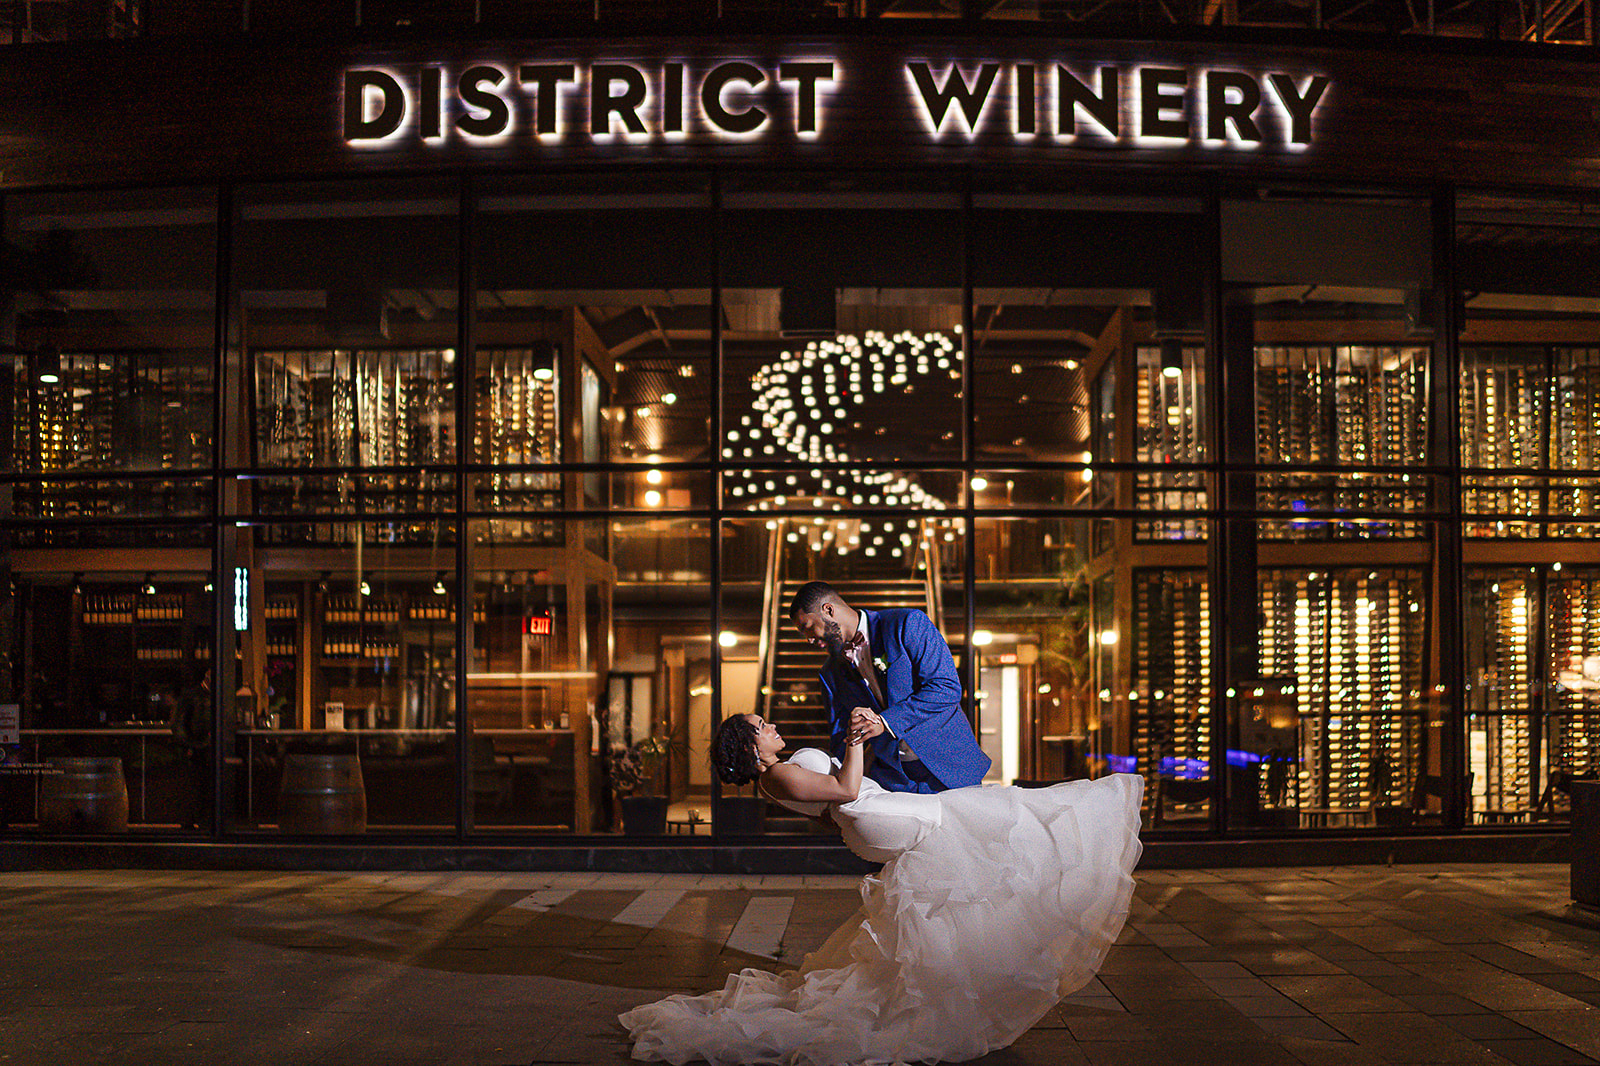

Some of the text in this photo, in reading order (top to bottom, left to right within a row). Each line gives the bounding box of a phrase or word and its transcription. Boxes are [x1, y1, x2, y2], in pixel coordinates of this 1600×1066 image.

[343, 60, 1331, 147] DISTRICT WINERY
[531, 617, 550, 634] EXIT
